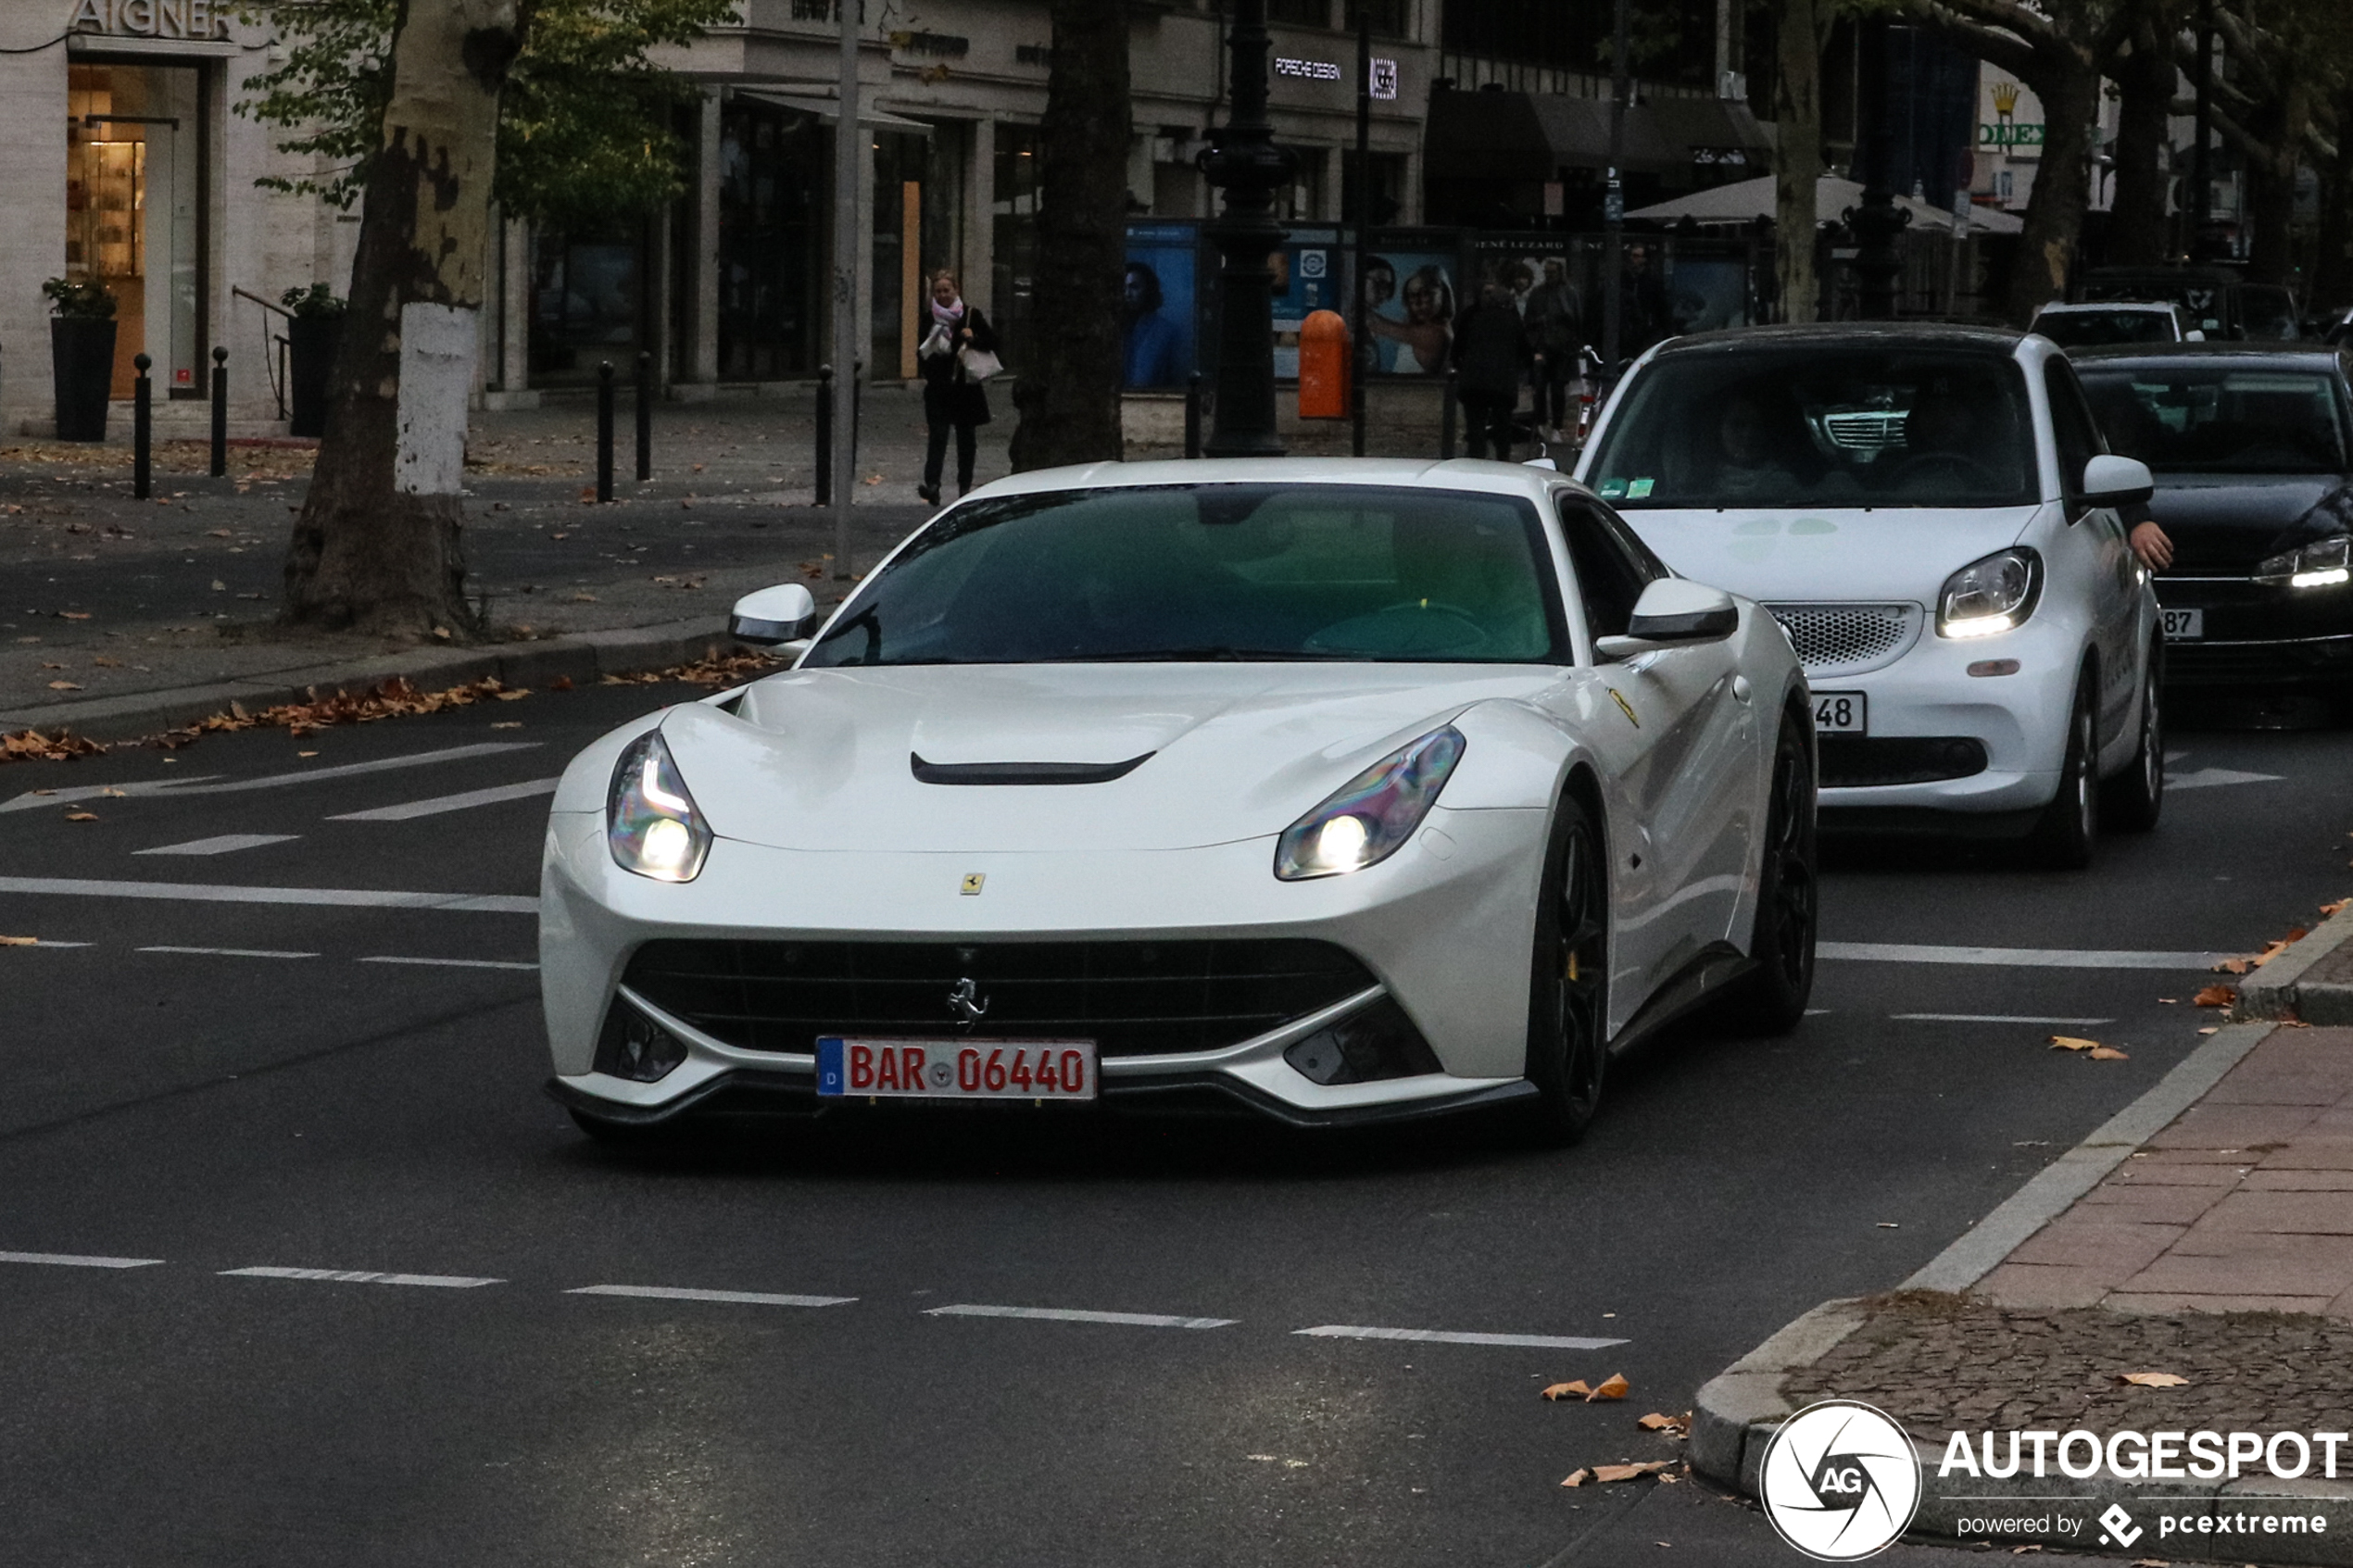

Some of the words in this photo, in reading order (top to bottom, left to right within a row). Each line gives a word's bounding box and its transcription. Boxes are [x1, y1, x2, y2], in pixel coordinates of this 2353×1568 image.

[69, 0, 232, 40] AIGNER
[1276, 57, 1311, 78] PORSCHE
[1312, 61, 1341, 81] DESIGN
[1816, 698, 1852, 727] 48
[826, 1073, 837, 1085] D
[850, 1045, 925, 1090] BAR
[958, 1048, 1084, 1093] 06440
